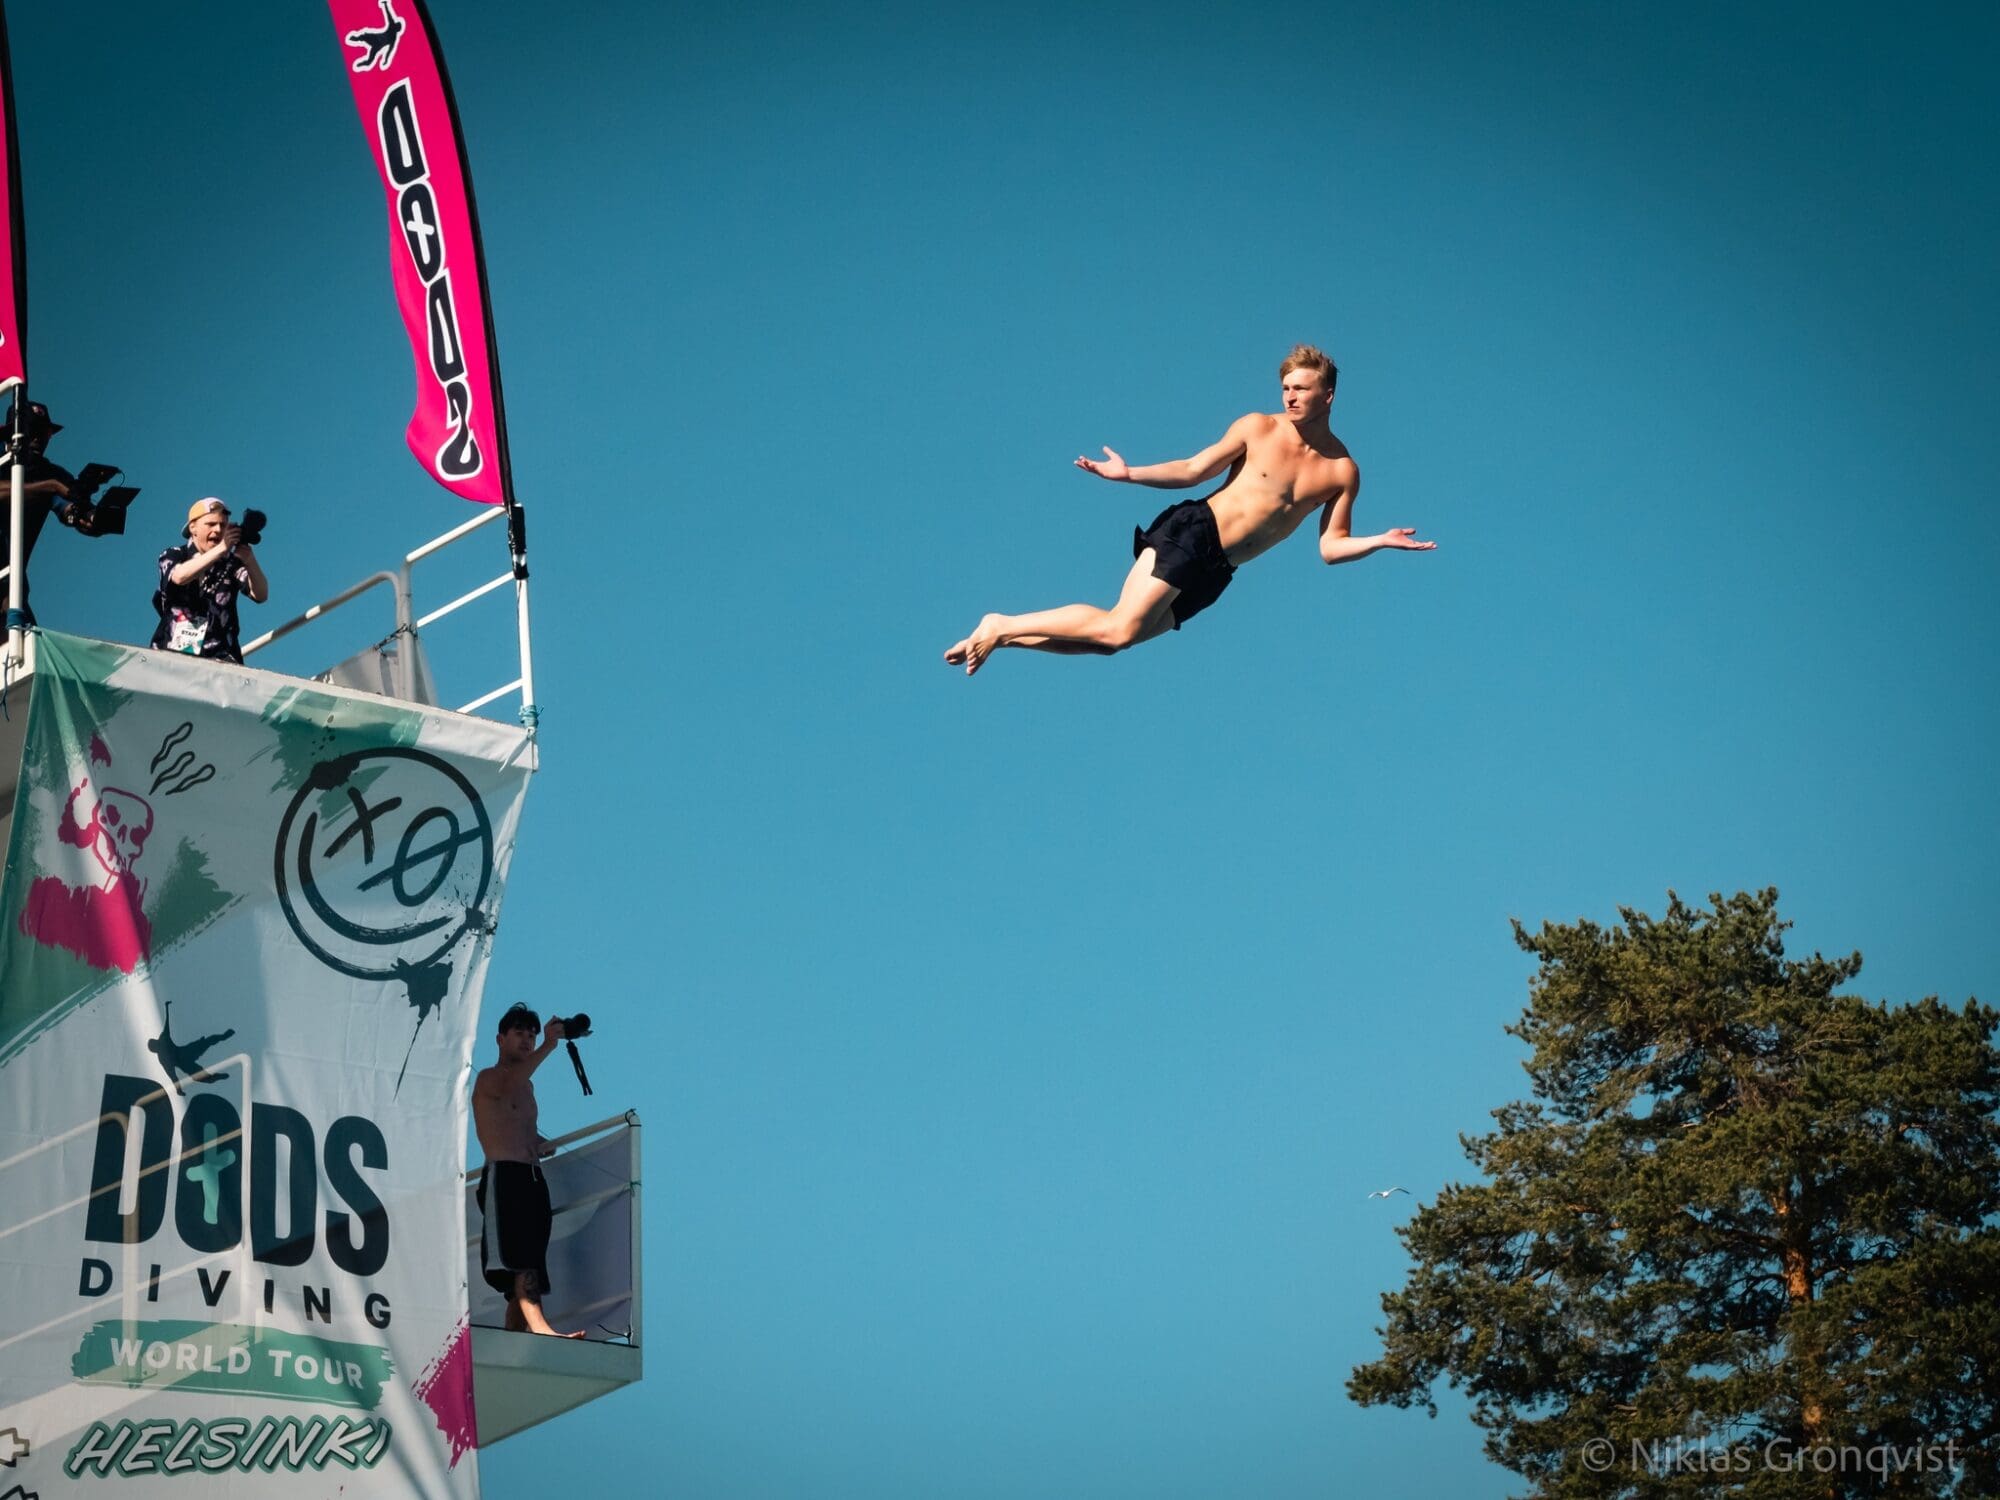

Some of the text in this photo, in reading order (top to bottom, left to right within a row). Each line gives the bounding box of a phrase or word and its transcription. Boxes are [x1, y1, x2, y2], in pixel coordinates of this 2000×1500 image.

[85, 1073, 391, 1277] DODS
[79, 1257, 392, 1329] DIVING
[110, 1338, 365, 1390] WORLD TOUR
[64, 1415, 394, 1478] HELSINKI
